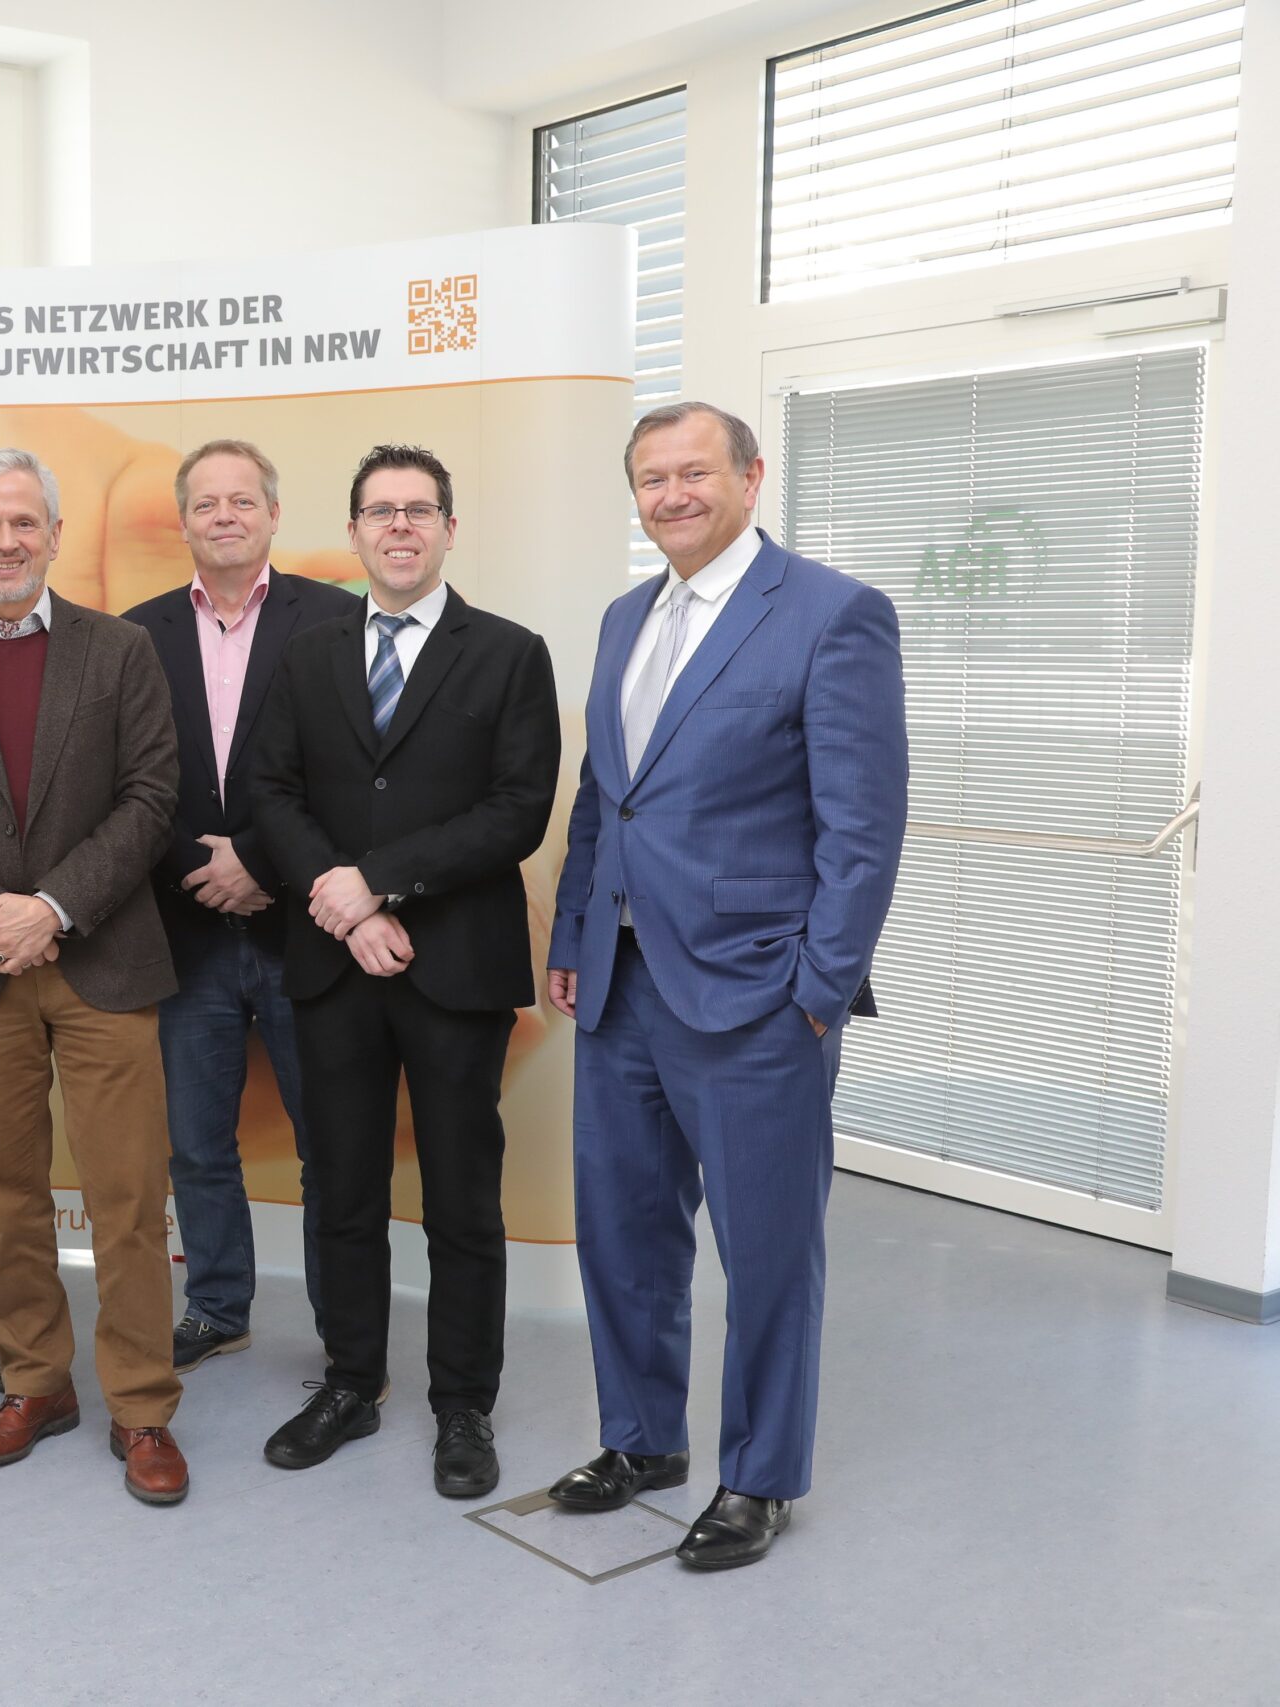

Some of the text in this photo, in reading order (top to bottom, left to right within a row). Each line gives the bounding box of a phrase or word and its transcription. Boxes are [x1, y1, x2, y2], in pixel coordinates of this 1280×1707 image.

[24, 299, 210, 334] NETZWERK
[219, 294, 284, 326] DER
[259, 336, 293, 367] IN
[304, 328, 382, 364] NRW
